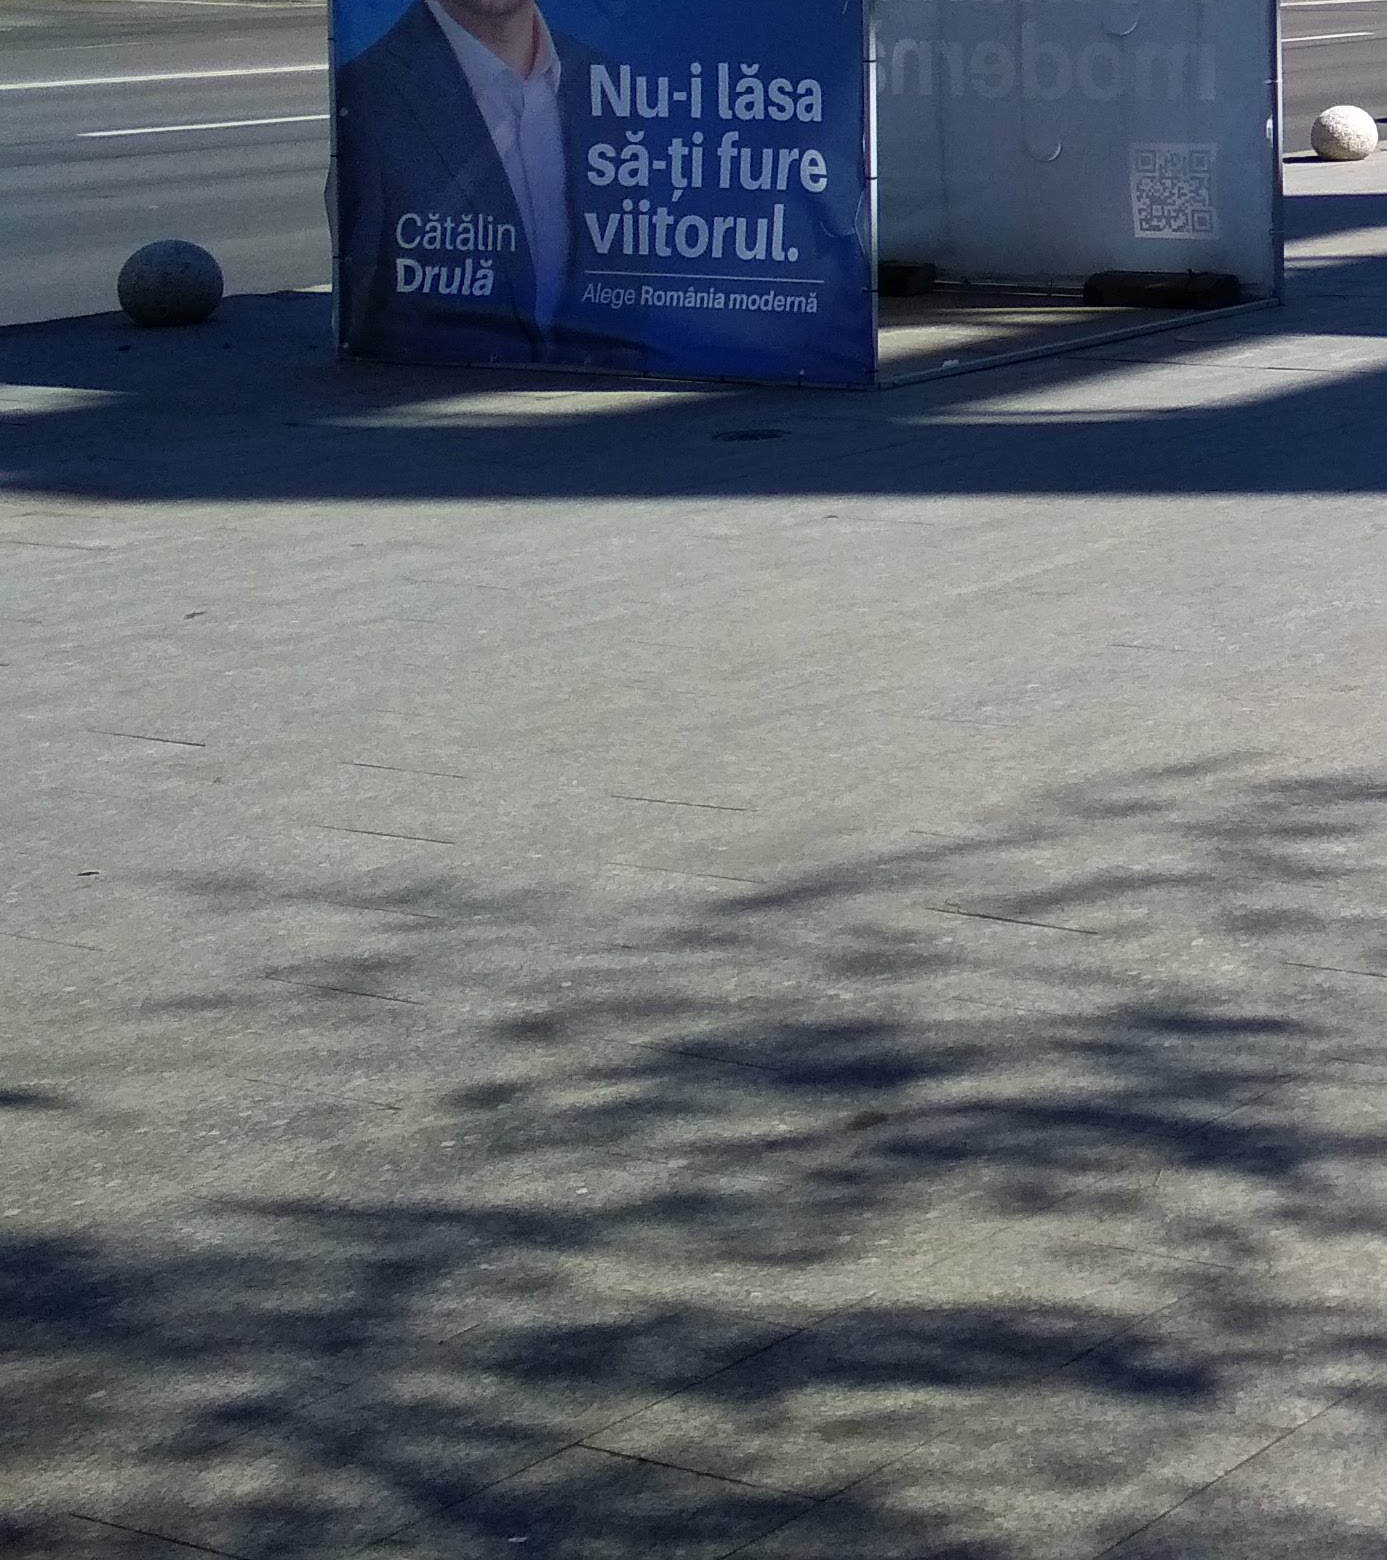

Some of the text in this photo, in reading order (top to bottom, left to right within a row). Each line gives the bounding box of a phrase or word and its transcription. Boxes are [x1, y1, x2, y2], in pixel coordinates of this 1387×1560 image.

[590, 62, 823, 122] Nu-i lăsa
[587, 130, 828, 202] să-ți fure
[396, 213, 516, 252] Cătălin
[583, 198, 799, 263] viitorul.
[395, 258, 494, 296] Drulă
[582, 283, 818, 314] Alege România modernă
